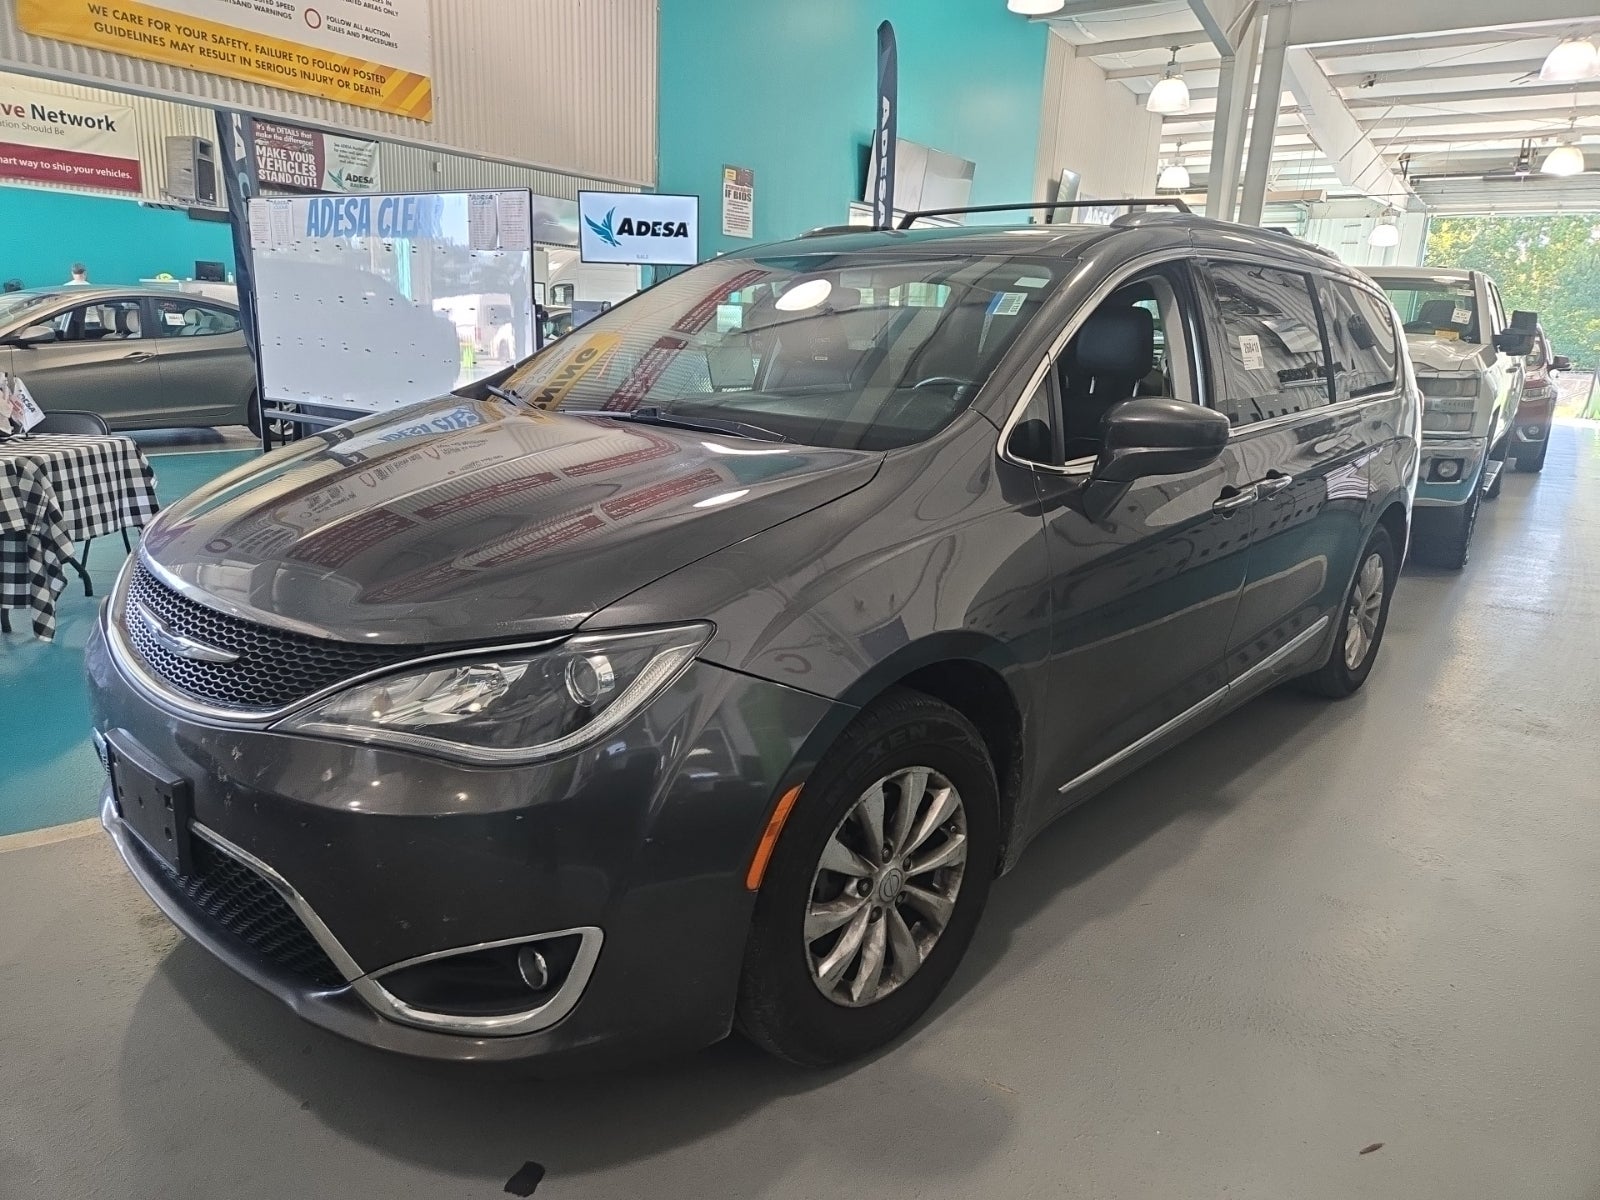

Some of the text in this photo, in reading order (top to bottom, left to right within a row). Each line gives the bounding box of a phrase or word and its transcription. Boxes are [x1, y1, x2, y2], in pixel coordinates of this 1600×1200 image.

[254, 4, 292, 20] WARNINGS
[276, 1, 296, 12] SPEED
[364, 2, 382, 12] AREAS
[383, 8, 399, 16] ONLY
[326, 14, 391, 38] FOLLOW ALL AUCTION
[88, 2, 386, 84] WE CARE FOR YOUR SAFETY. FAILURE TO FOLLOW POSTED
[326, 24, 398, 50] RULES AND PROCEDURES
[94, 22, 384, 98] GUIDELINES MAY RESULT IN SERIOUS INJURY OR DEATH.
[30, 103, 118, 132] Network
[22, 122, 52, 134] Should
[54, 127, 65, 136] Be
[266, 124, 276, 132] the
[276, 125, 300, 137] DETAILS
[300, 130, 312, 140] that
[256, 131, 314, 148] make the difference!
[256, 145, 316, 165] MAKE YOUR
[878, 96, 890, 227] ADESA
[19, 159, 39, 170] way
[40, 161, 51, 169] to
[52, 162, 72, 173] ship
[73, 166, 94, 176] your
[95, 167, 132, 180] vehicles.
[258, 156, 317, 178] VEHICLES
[258, 169, 318, 188] STAND OUT!
[344, 172, 374, 184] ADESA
[725, 190, 752, 202] IF BIDS
[306, 198, 371, 238] ADESA
[616, 218, 689, 238] ADESA
